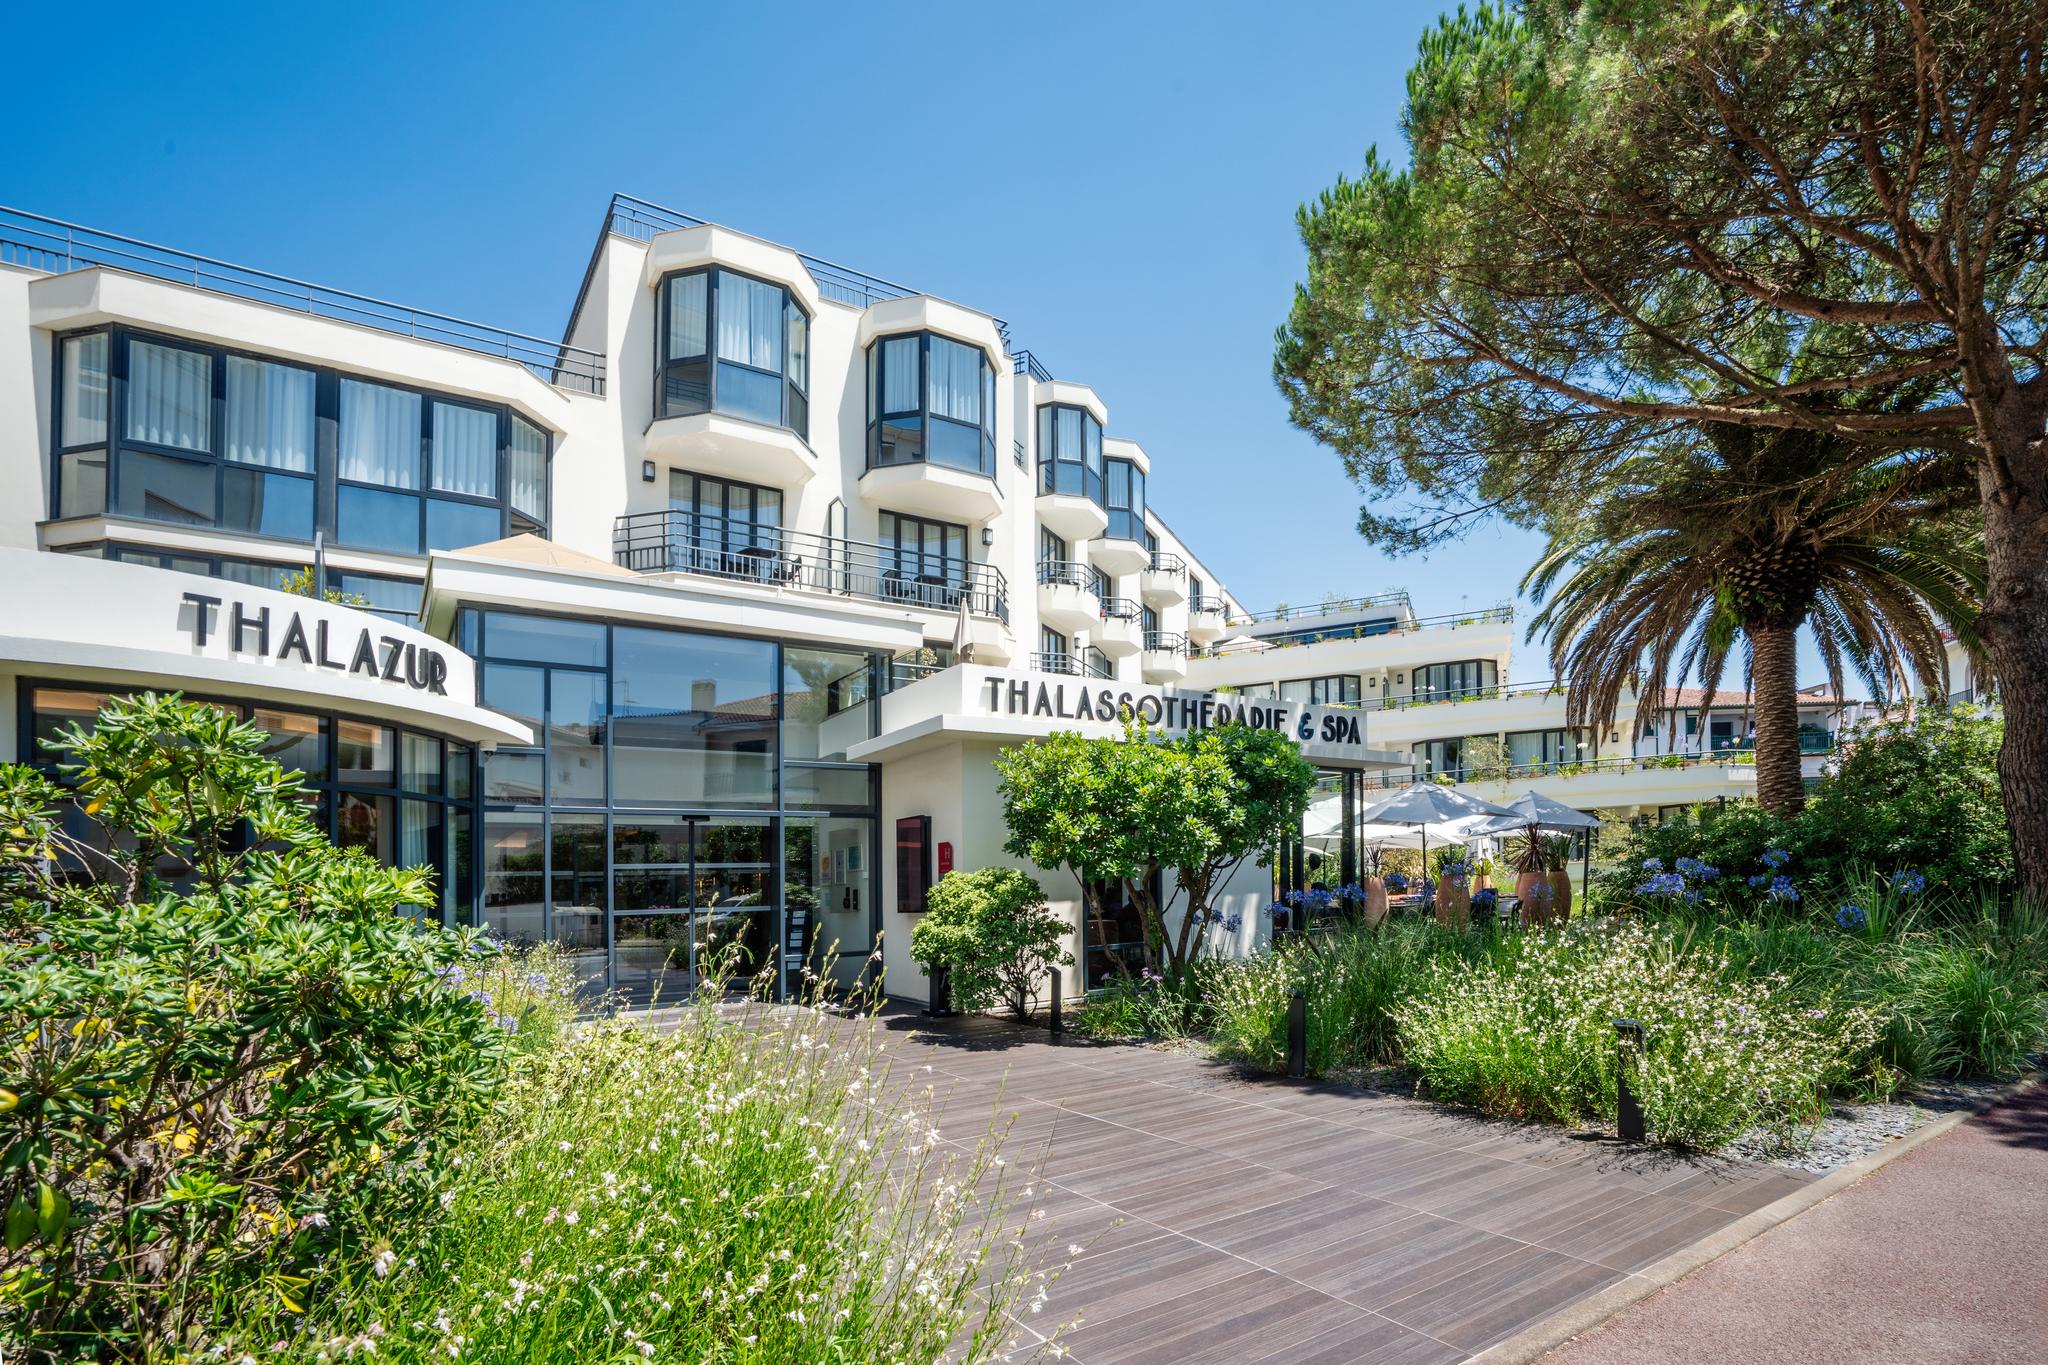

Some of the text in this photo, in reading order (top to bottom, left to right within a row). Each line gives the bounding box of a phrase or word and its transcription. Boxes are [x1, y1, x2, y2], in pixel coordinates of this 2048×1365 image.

[183, 592, 448, 697] THALAZUR
[1298, 712, 1315, 740] &
[1320, 714, 1362, 745] SPA
[944, 847, 951, 859] H
